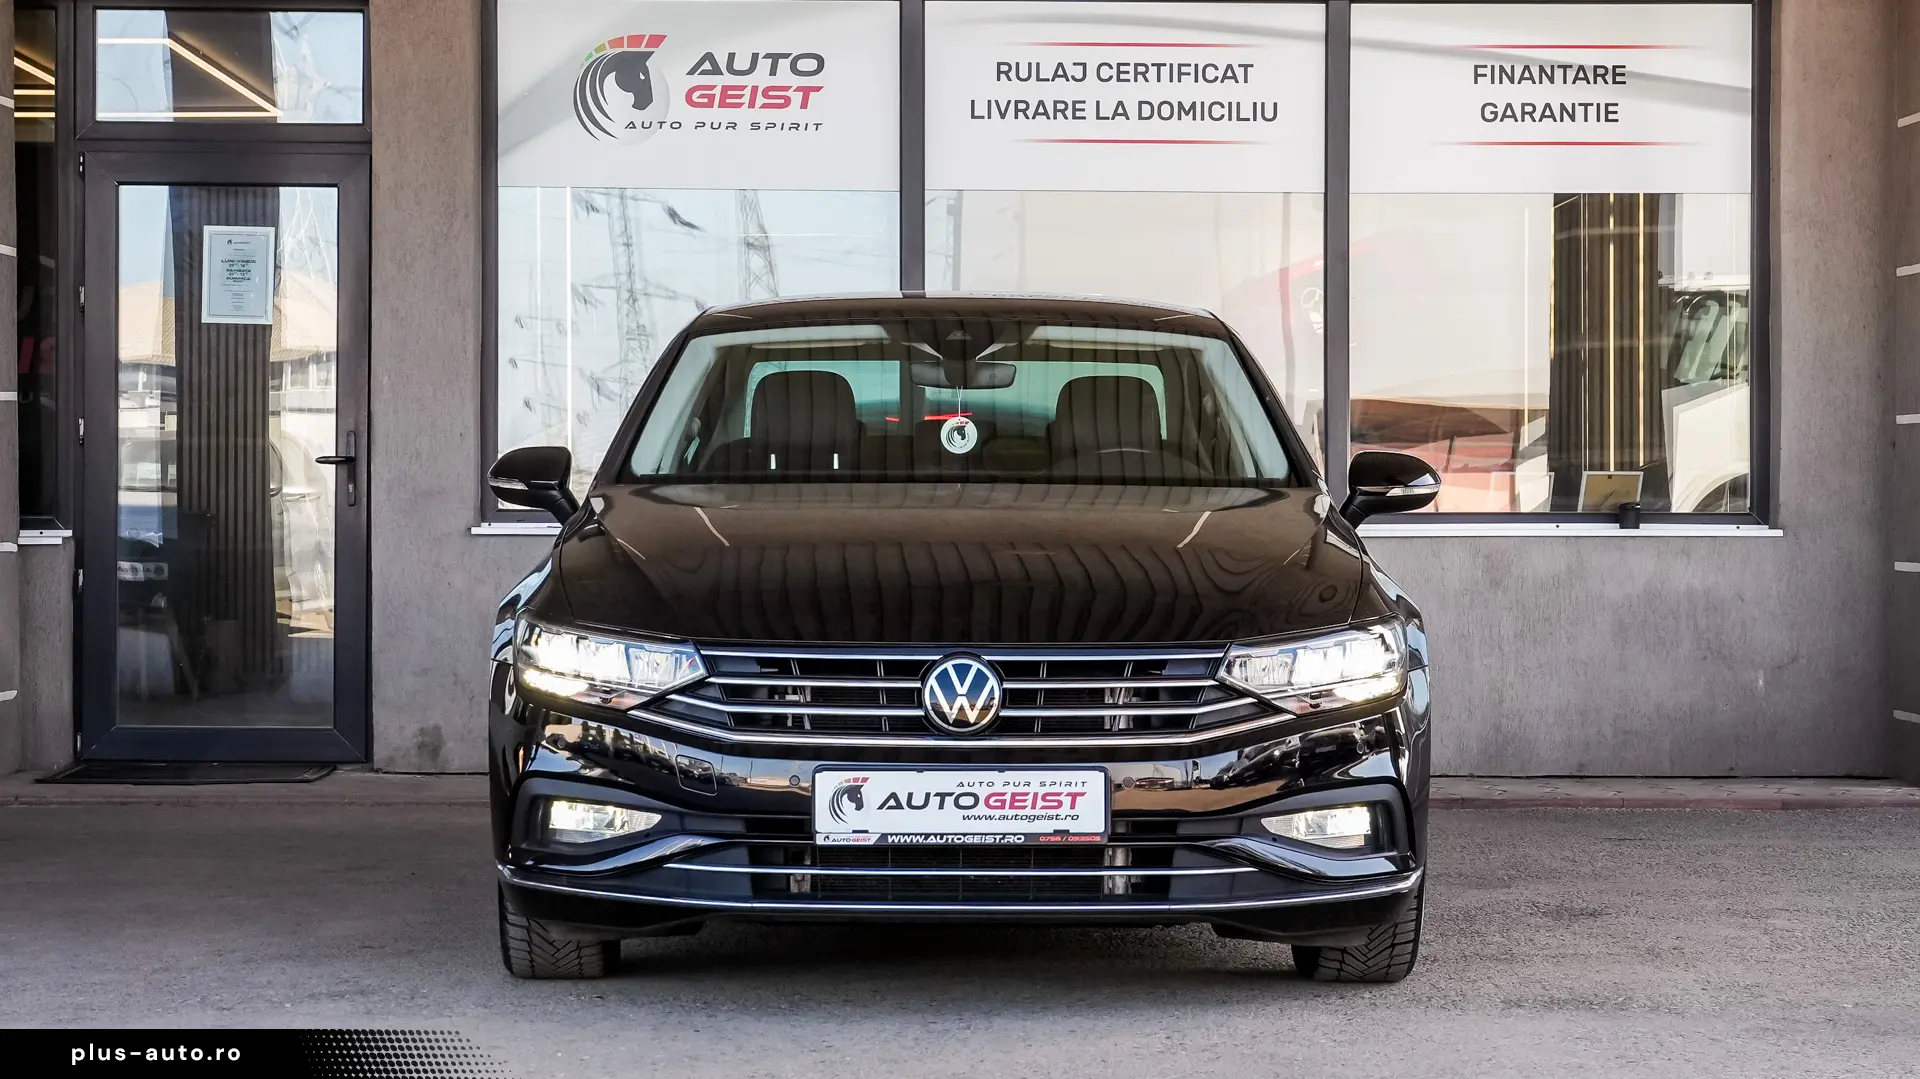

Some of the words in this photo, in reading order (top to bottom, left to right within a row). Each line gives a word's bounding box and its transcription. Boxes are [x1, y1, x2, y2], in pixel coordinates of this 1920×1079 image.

[685, 51, 825, 77] AUTO
[995, 61, 1088, 83] RULAJ
[1095, 62, 1254, 84] CERTIFICAT
[1473, 64, 1627, 85] FINANTARE
[685, 84, 824, 110] GEIST
[970, 99, 1087, 121] LIVRARE
[1095, 100, 1130, 121] LA
[1137, 100, 1278, 122] DOMICILIU
[1480, 102, 1619, 123] GARANTIE
[624, 120, 683, 130] AUTO
[694, 121, 738, 131] PUR
[749, 121, 824, 132] SPIRIT
[962, 812, 1080, 823] www.autogeist.ro
[887, 834, 1025, 844] WWW.AUTOGEIST.RO
